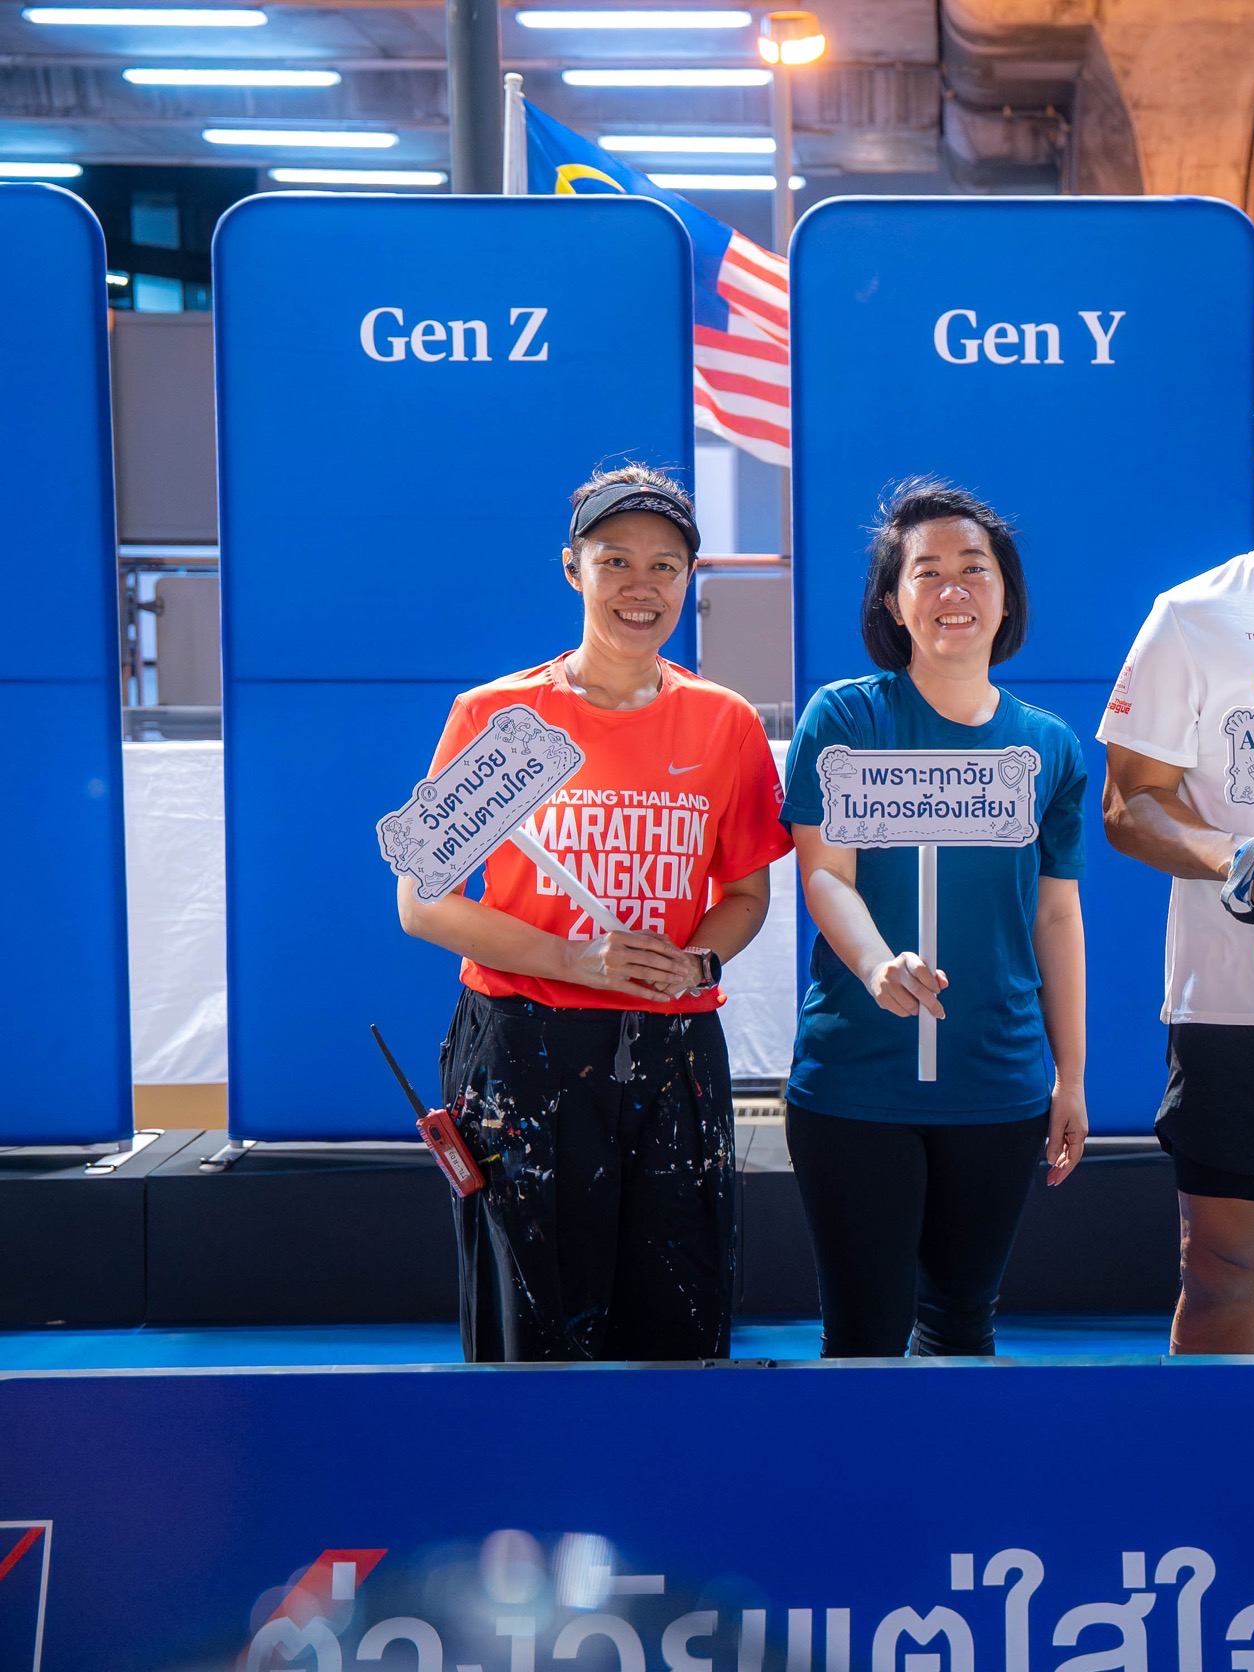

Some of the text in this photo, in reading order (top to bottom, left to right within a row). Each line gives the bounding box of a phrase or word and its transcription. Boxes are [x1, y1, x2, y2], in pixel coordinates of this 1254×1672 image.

[360, 307, 548, 362] Gen Z
[934, 309, 1126, 364] Gen Y
[1107, 702, 1131, 714] ague
[418, 748, 507, 831] วิ่งตามวัย
[861, 761, 994, 793] เพราะทุกวัย
[431, 757, 545, 865] แต่ไม่ตามใคร
[620, 790, 710, 811] THAILAND
[841, 786, 1016, 819] ไม่ควรต้องเสี่ยง
